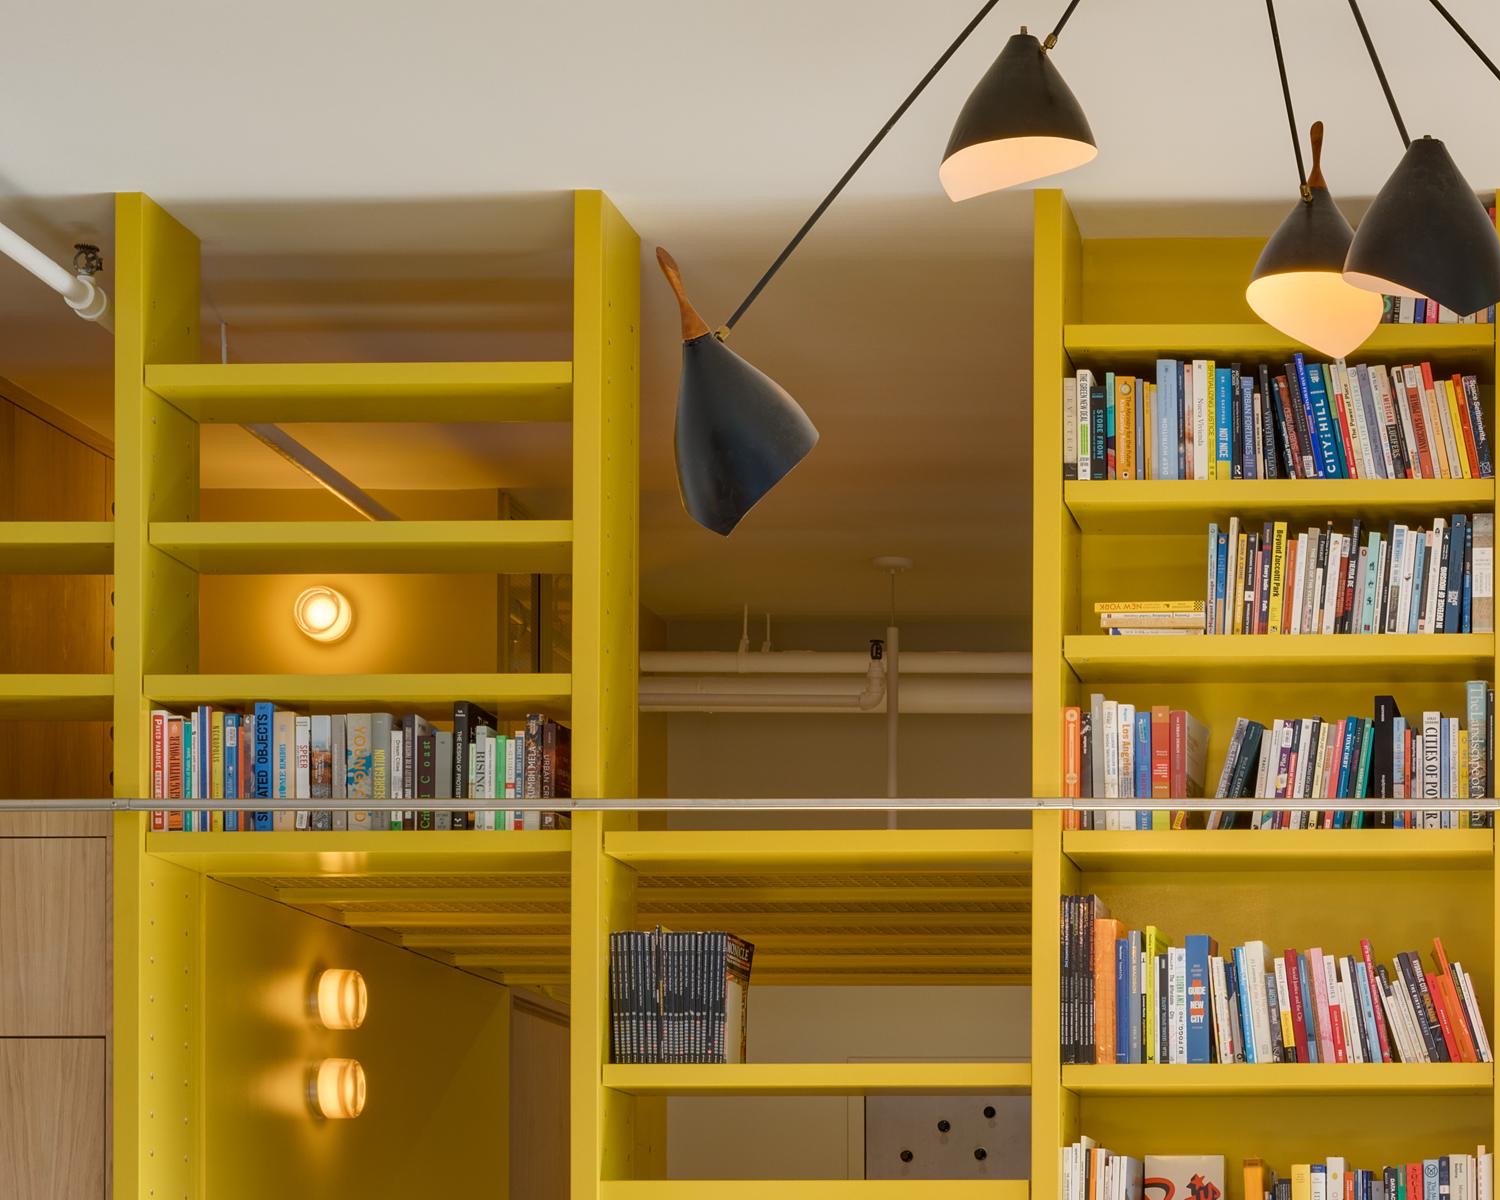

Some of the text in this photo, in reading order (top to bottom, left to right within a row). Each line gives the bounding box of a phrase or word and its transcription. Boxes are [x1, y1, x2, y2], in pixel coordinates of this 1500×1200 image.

[1080, 374, 1088, 422] THE GREEN NEW DEAL
[1244, 388, 1253, 455] URBAN FORTUNES
[1219, 428, 1228, 457] NOT NICE
[1315, 400, 1335, 473] CITY HILL
[1274, 530, 1283, 553] Beyond
[1273, 555, 1282, 578] Zuccotti
[258, 714, 268, 764] OBJECTS
[1120, 724, 1131, 776] Los Angeles
[1344, 734, 1352, 750] TOXIC
[1425, 728, 1438, 761] CITIES
[300, 745, 308, 768] SPEER
[476, 752, 485, 792] RISING
[1188, 987, 1205, 995] GUIDE
[1190, 1001, 1204, 1009] NEW
[1190, 1014, 1204, 1023] CITY
